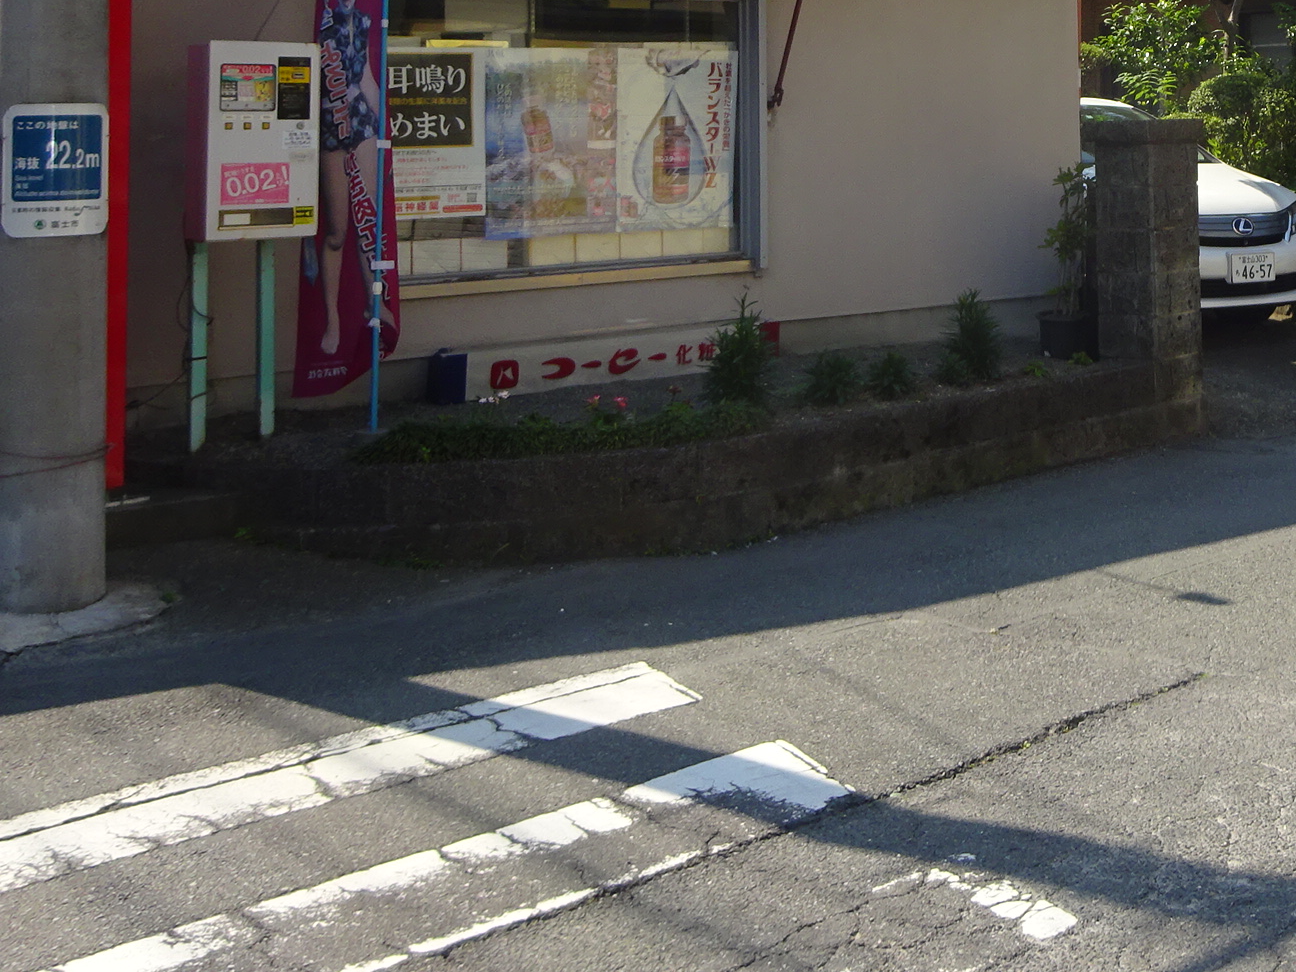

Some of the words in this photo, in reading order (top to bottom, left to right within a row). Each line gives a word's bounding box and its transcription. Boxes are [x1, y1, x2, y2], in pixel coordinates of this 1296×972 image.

[387, 64, 467, 95] 耳鳴り
[389, 111, 466, 139] めまい
[14, 156, 40, 170] 海抜
[45, 139, 100, 170] 22.2m
